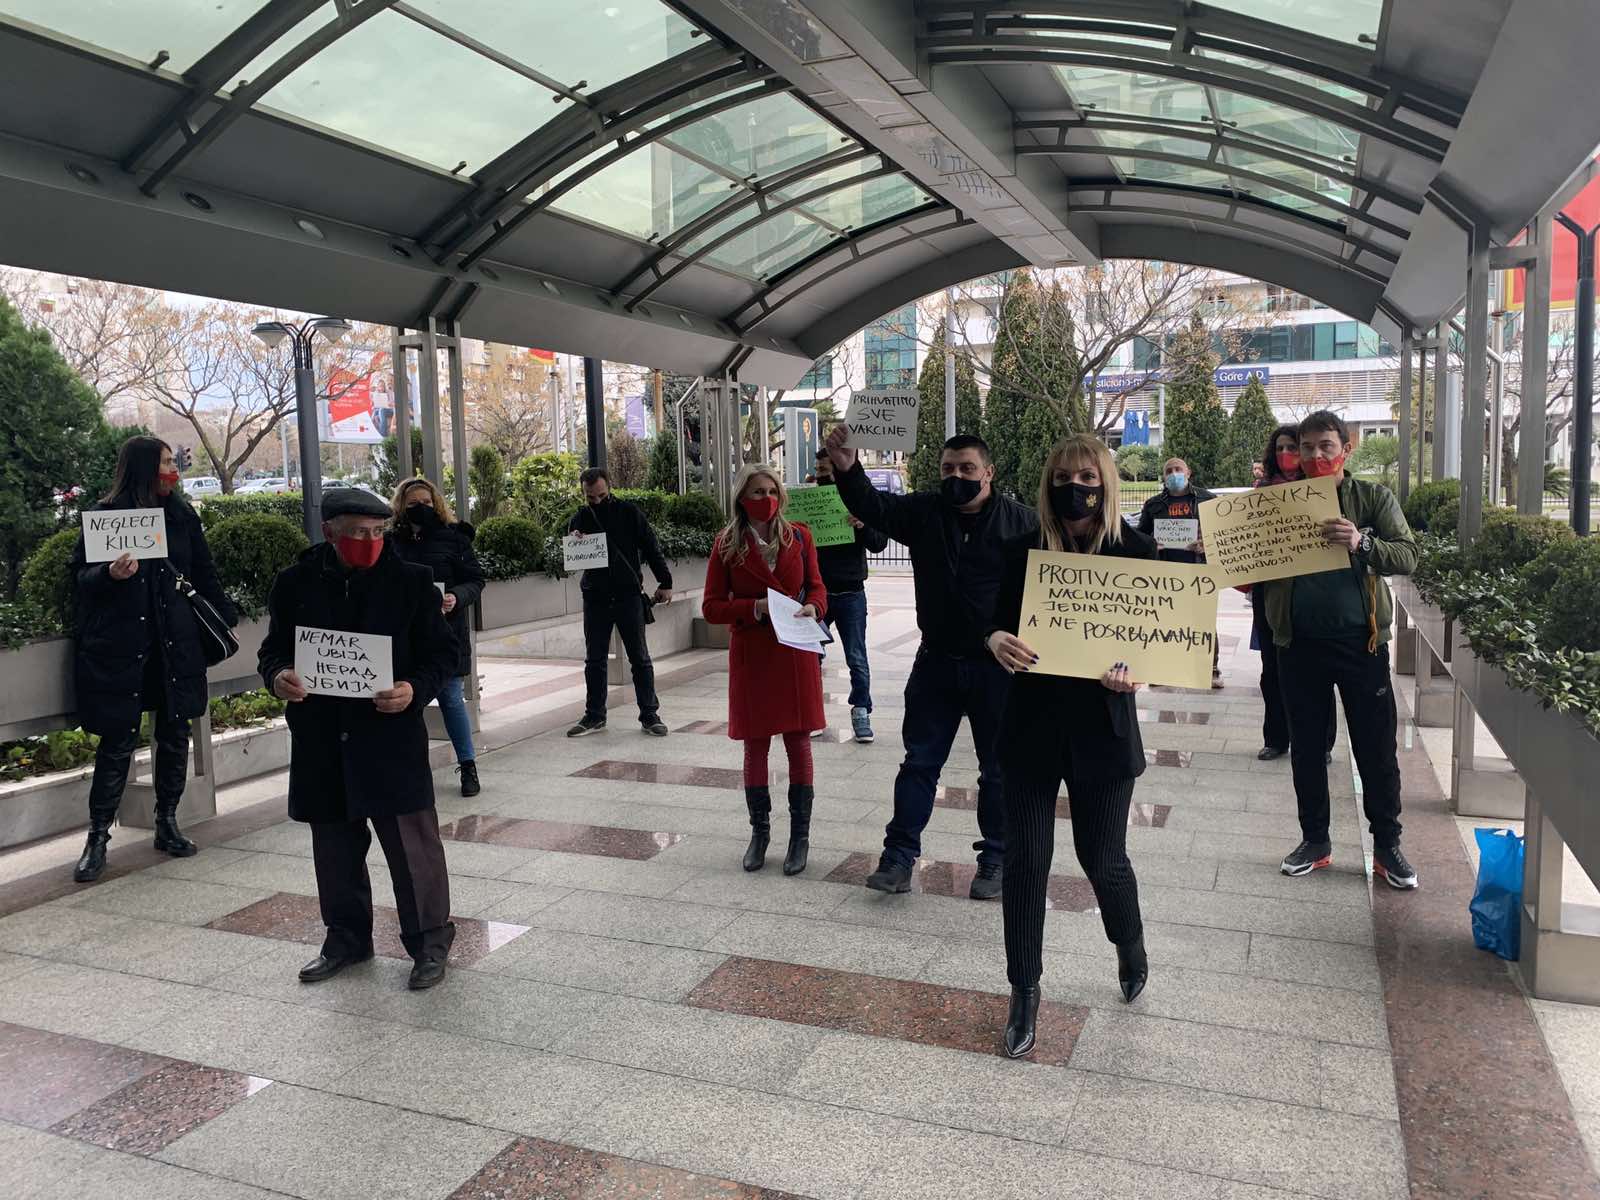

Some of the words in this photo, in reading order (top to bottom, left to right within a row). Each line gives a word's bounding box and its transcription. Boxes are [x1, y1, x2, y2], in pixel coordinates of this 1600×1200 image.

[1220, 371, 1243, 381] Gore
[853, 394, 917, 408] PRIHVATIMO
[857, 408, 897, 421] SVE
[848, 423, 908, 437] VAKCINE
[1215, 485, 1327, 517] OSTAVKA
[1246, 507, 1281, 520] ZBOG
[90, 515, 160, 534] NEGLECT
[105, 535, 156, 550] KILLS
[1215, 531, 1260, 549] NEMARA
[1274, 521, 1323, 535] NERADA
[1039, 563, 1109, 587] PROTIV
[1112, 573, 1185, 592] COVID
[1190, 576, 1216, 596] 19
[1049, 588, 1174, 610] NACIONALNIM
[1028, 614, 1038, 627] A
[1049, 616, 1077, 630] NE
[299, 630, 362, 650] NEMAR
[317, 647, 373, 662] UBIJA
